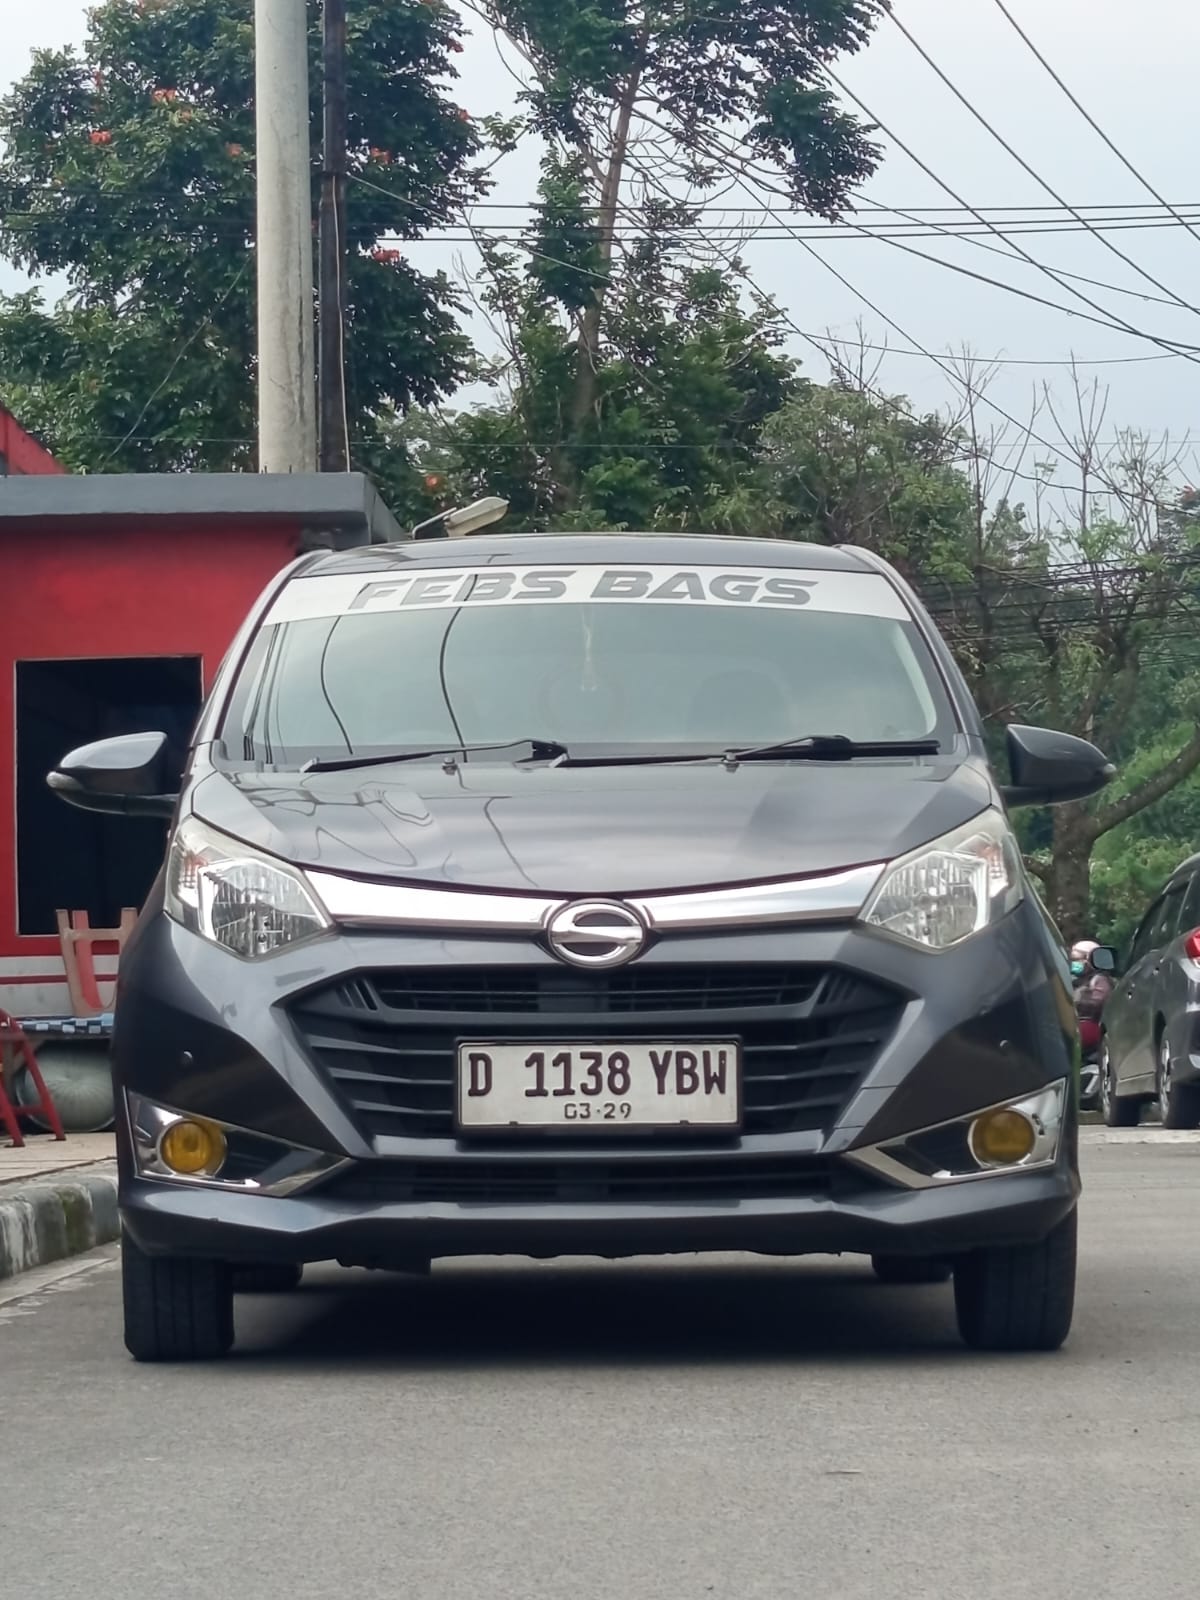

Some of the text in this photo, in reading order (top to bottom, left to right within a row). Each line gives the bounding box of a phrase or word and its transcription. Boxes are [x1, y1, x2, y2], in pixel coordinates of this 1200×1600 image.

[348, 570, 819, 610] FEBS BAGS
[467, 1050, 728, 1097] D 1138 YBW
